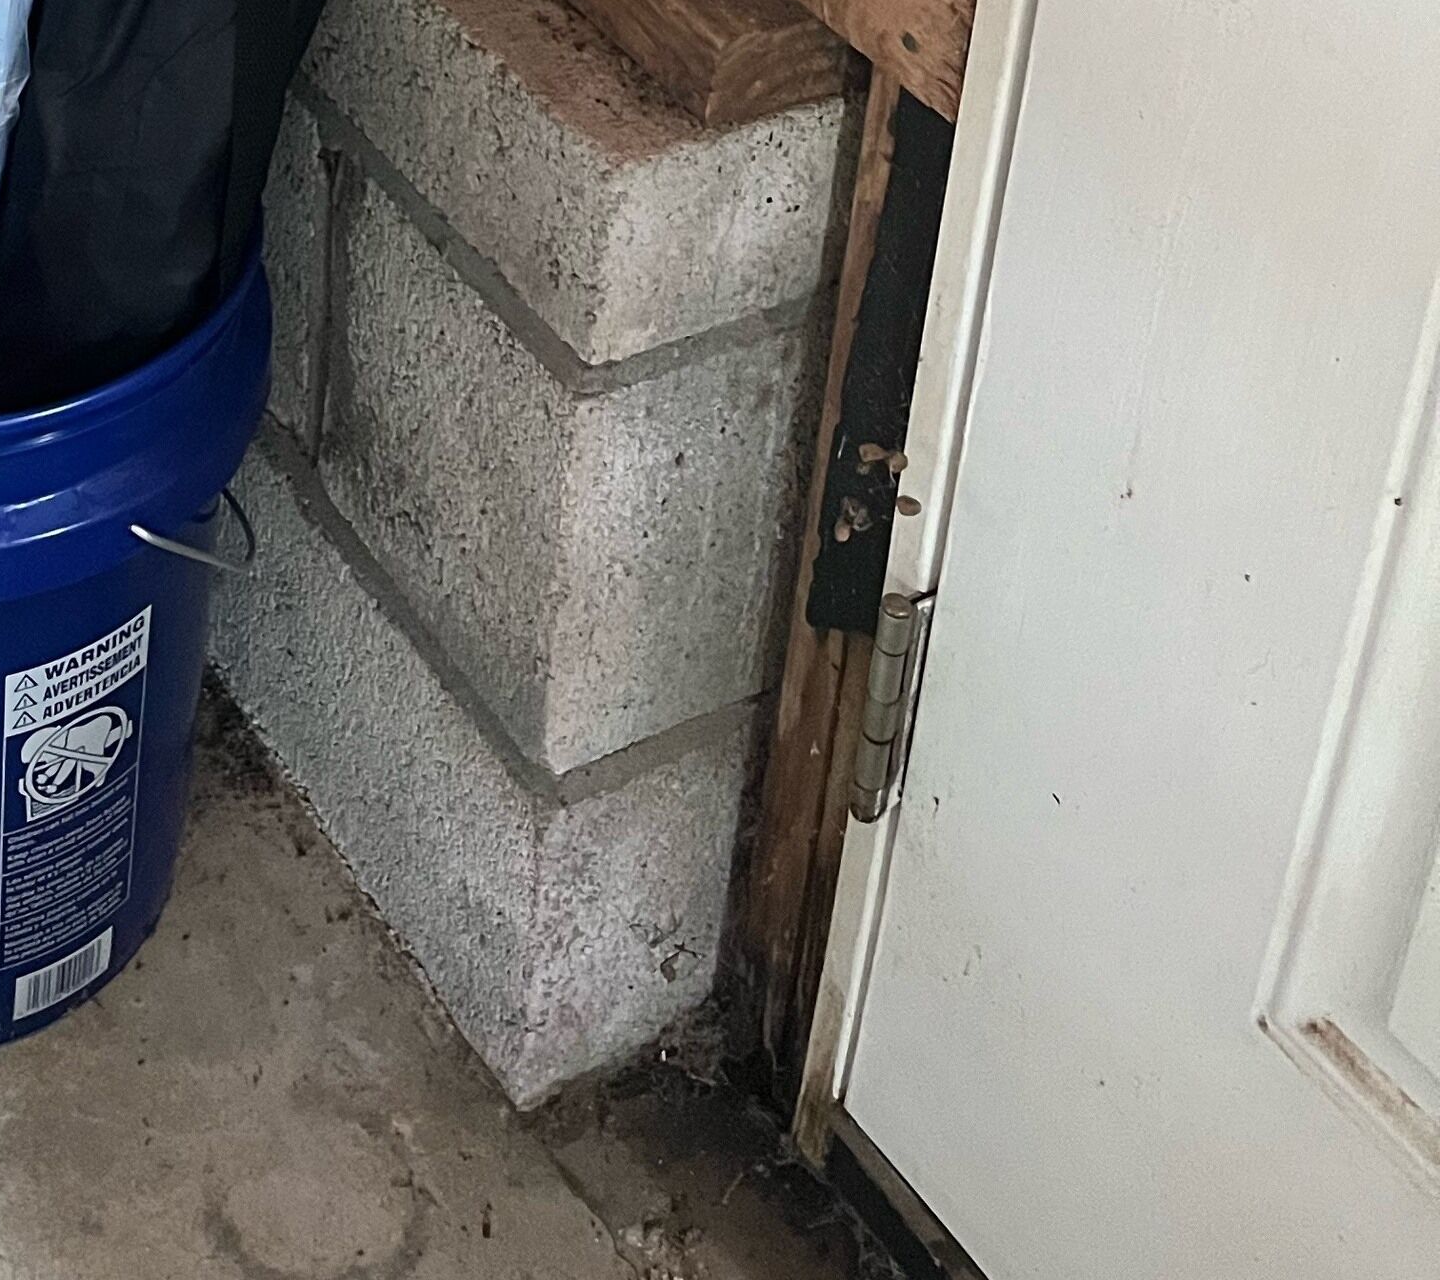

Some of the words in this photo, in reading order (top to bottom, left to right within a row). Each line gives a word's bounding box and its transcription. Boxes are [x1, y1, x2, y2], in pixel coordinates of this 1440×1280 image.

[43, 634, 144, 702] AVERTISSEMENT
[44, 615, 145, 680] WARNING
[42, 654, 141, 720] ADVERTENCIA
